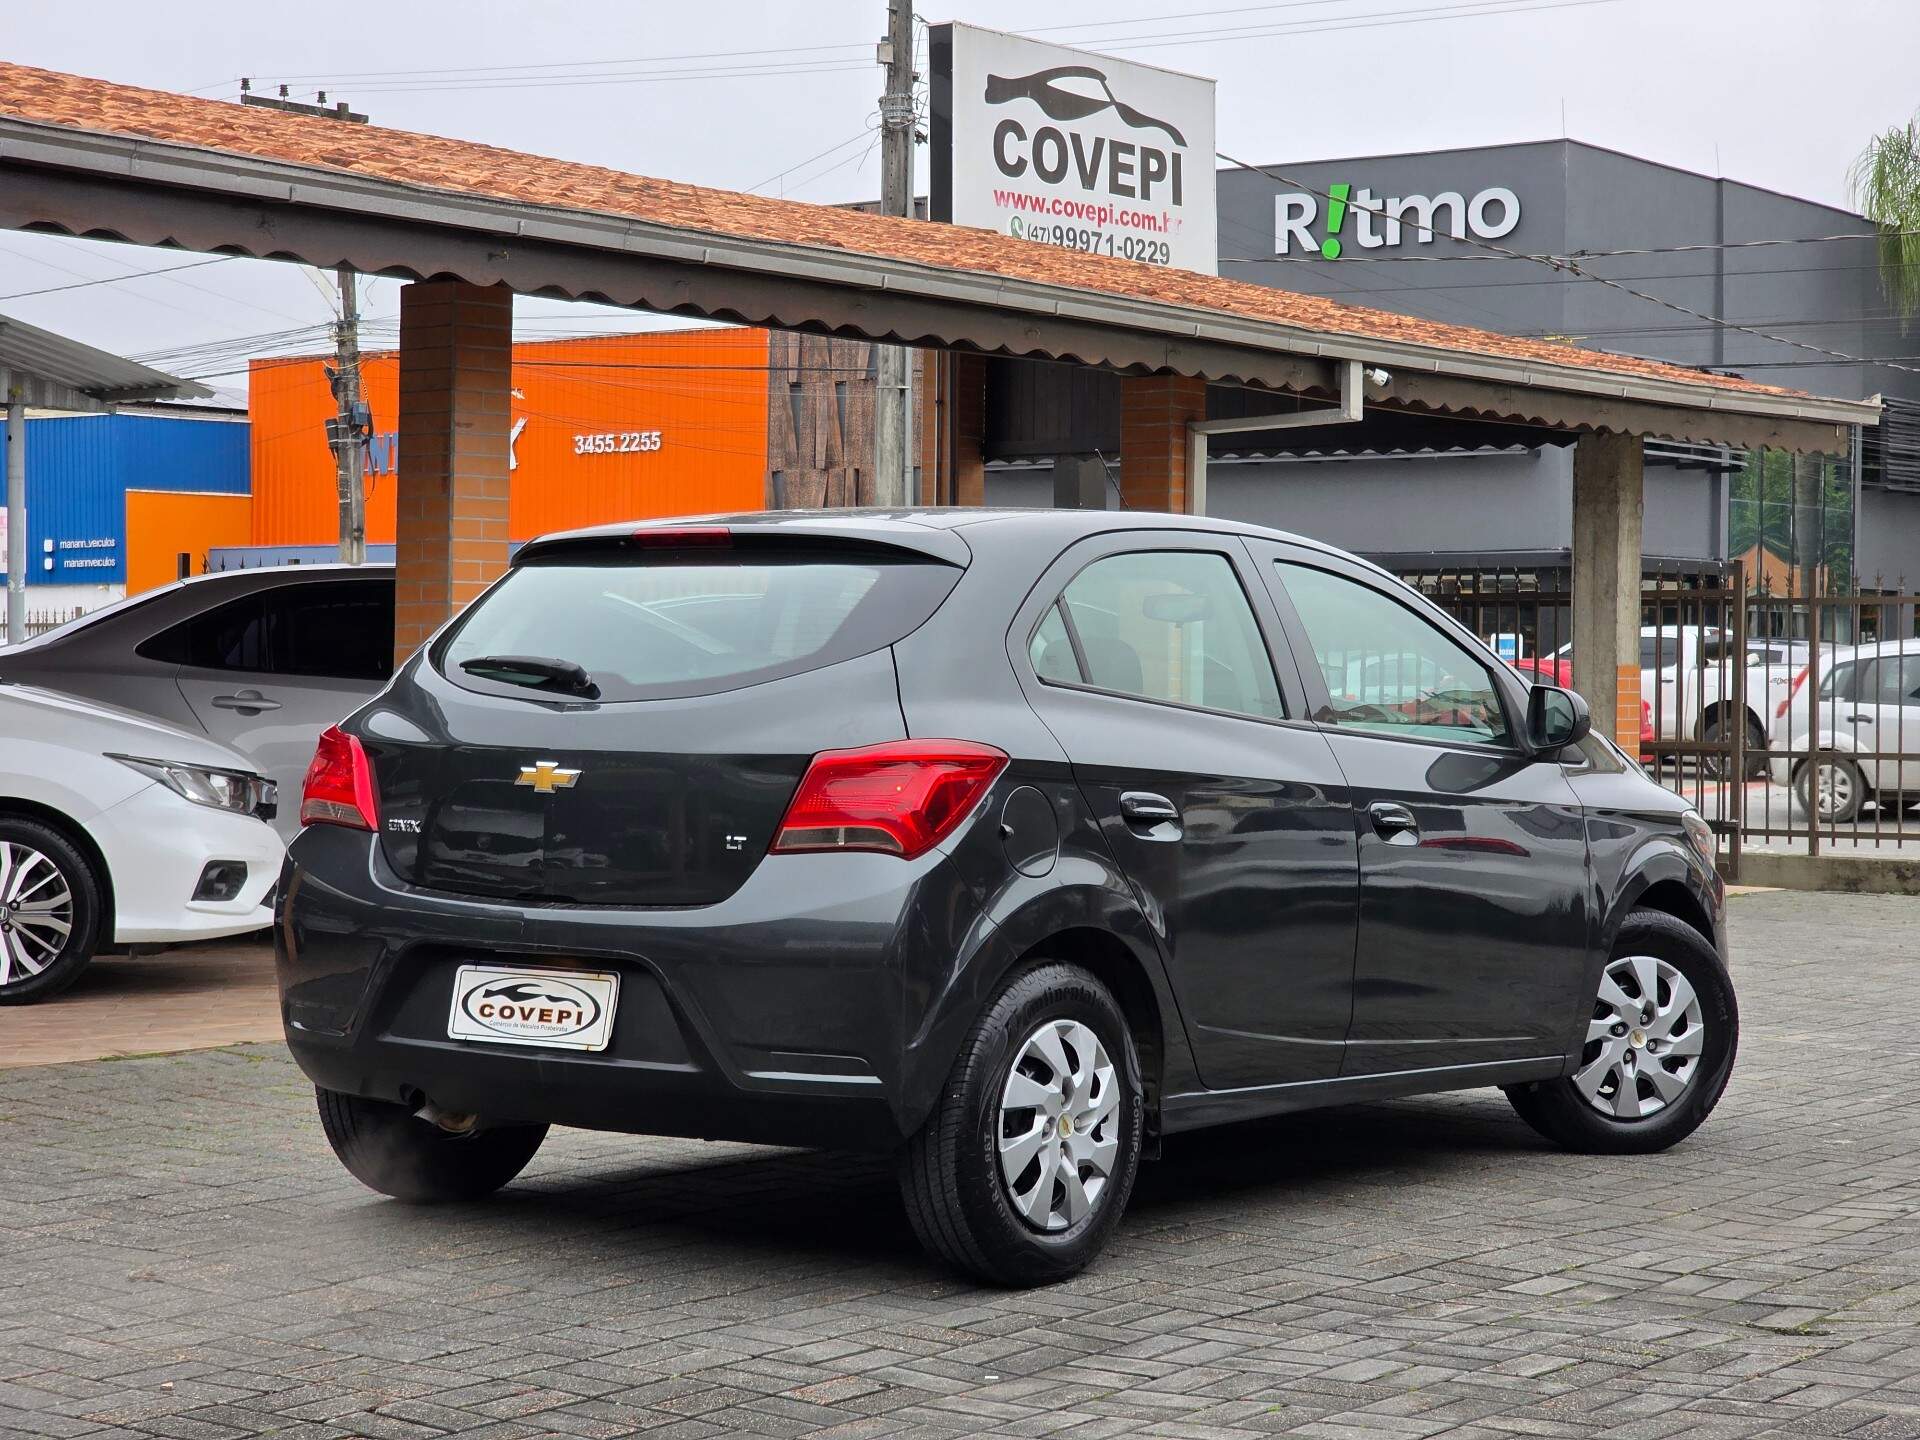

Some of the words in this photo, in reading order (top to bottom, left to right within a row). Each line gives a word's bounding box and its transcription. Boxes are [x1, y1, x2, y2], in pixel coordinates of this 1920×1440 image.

[993, 119, 1183, 207] COVEPI
[574, 431, 661, 455] 3455.2255
[388, 818, 422, 833] ONIX
[726, 835, 747, 850] LT
[479, 1003, 584, 1026] COVEPI
